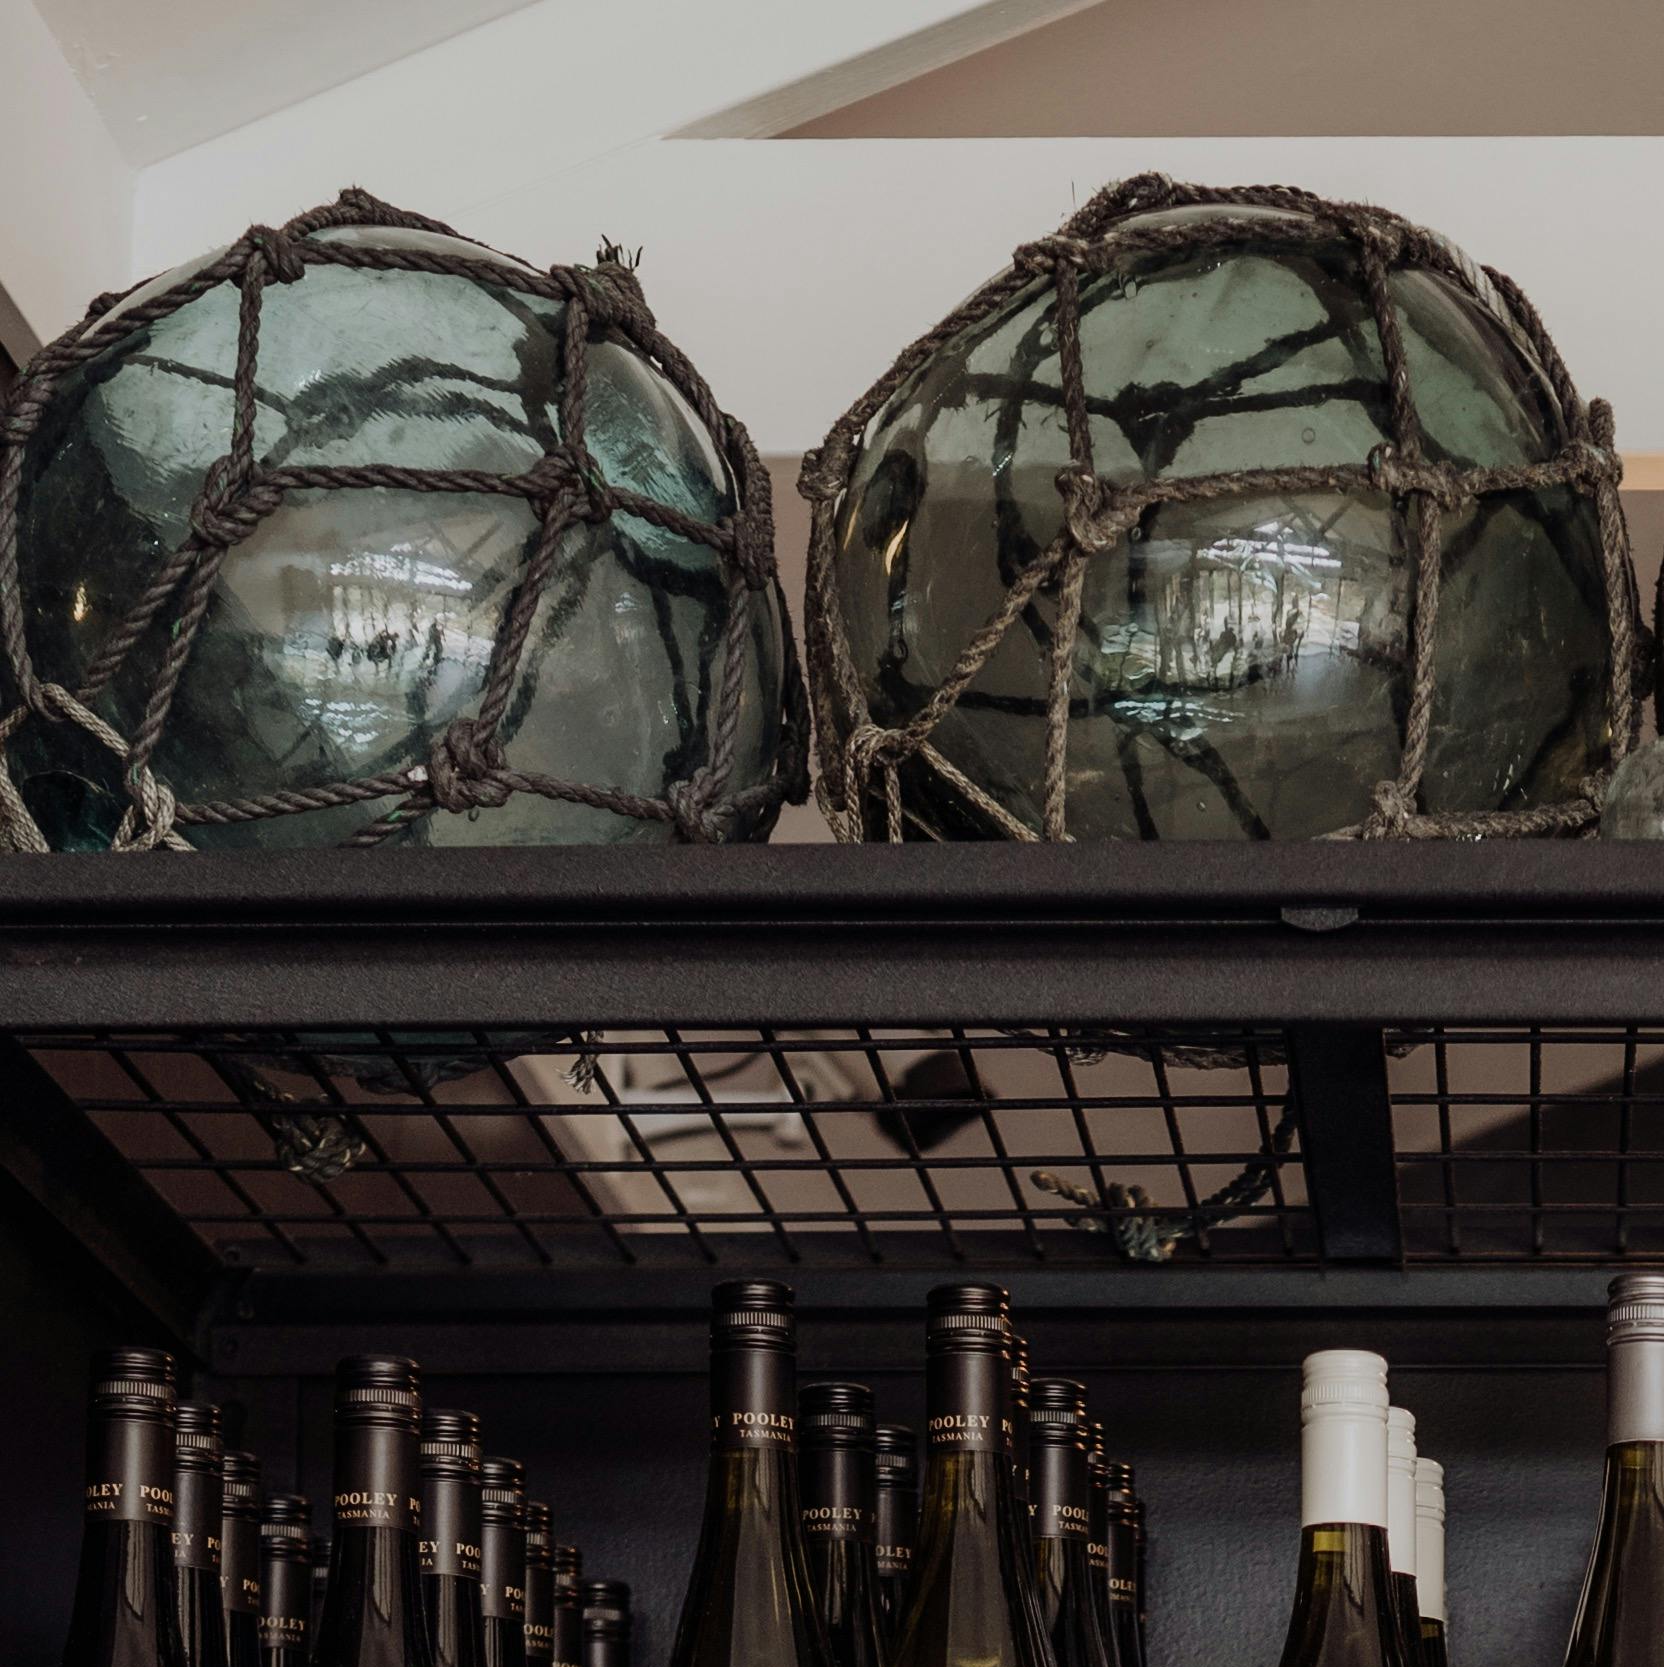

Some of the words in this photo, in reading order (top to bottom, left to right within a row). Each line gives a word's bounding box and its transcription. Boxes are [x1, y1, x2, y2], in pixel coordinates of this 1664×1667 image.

[733, 1412, 794, 1430] POOLEY
[929, 1415, 990, 1431] POOLEY
[740, 1429, 791, 1442] TASMANIA
[932, 1432, 983, 1443] TASMANIA
[335, 1492, 398, 1507] POOLEY
[338, 1509, 390, 1519] TASMANIA
[802, 1507, 862, 1520] POOLEY
[807, 1524, 856, 1532] TASMANIA
